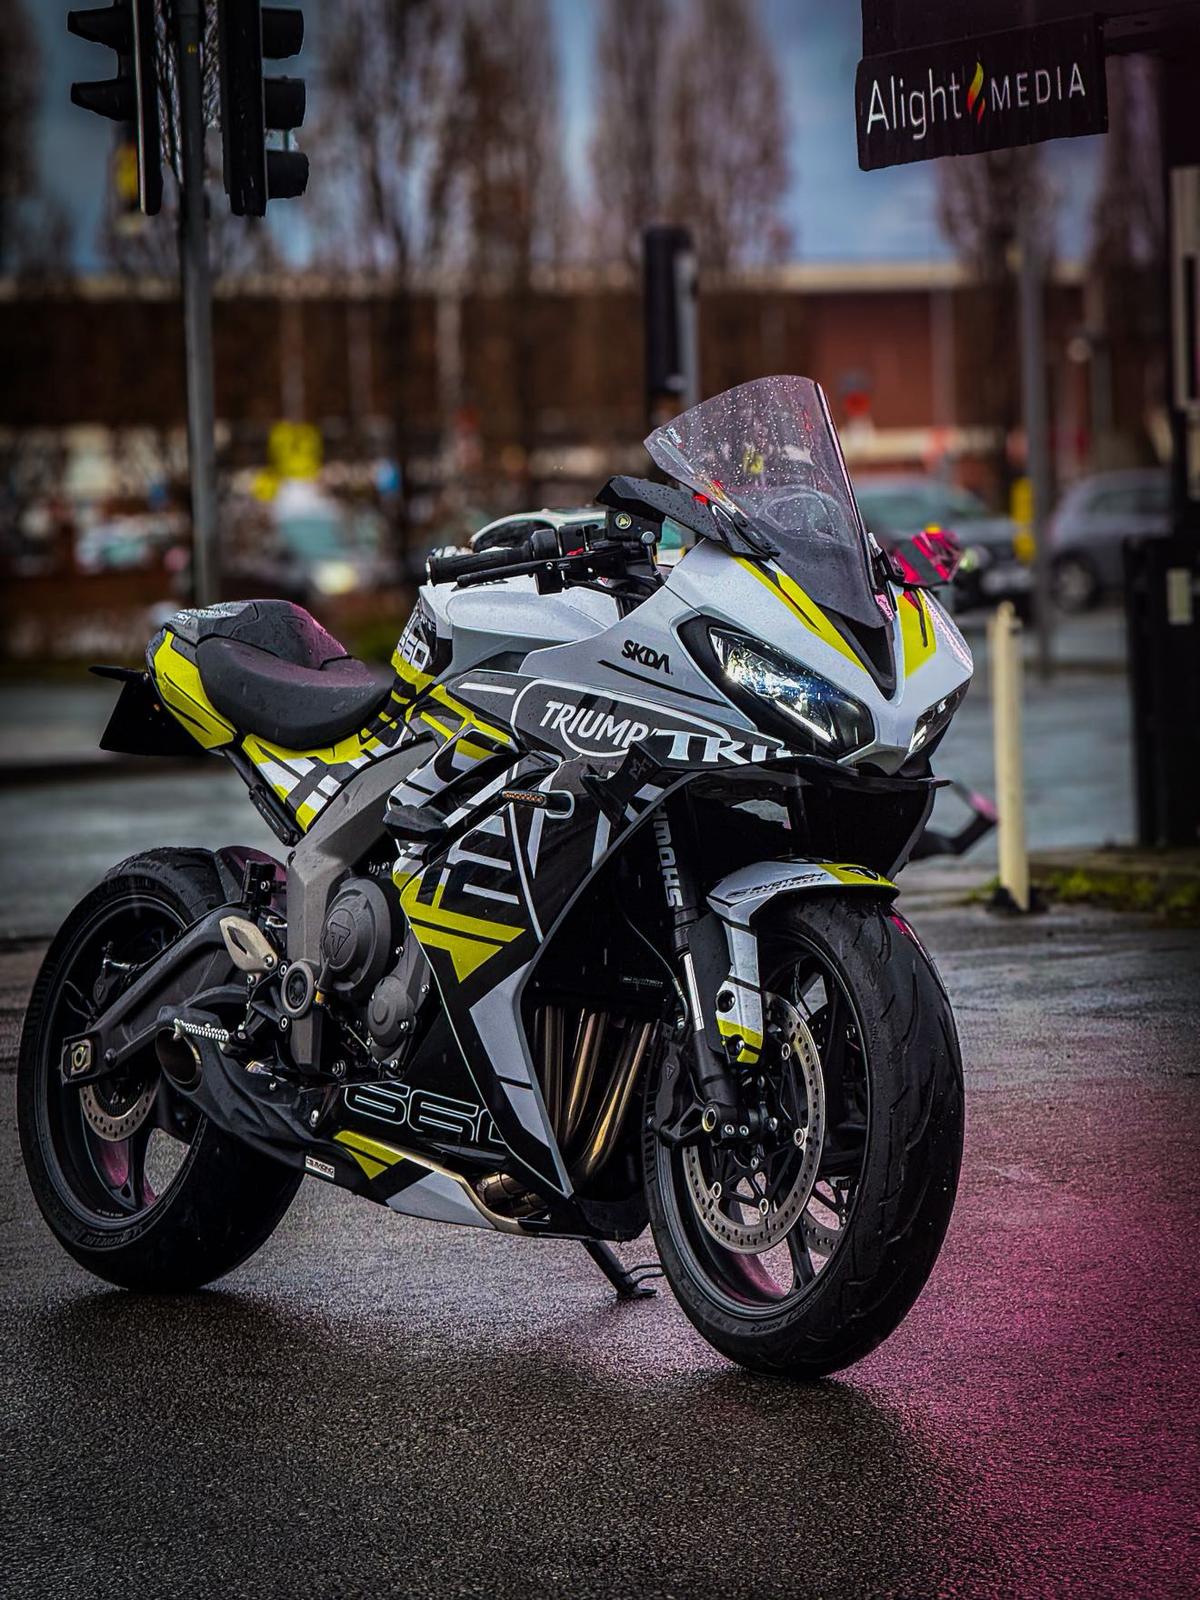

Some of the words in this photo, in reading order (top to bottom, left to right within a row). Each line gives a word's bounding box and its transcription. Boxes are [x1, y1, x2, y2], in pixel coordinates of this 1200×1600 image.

[866, 67, 963, 140] Alight
[990, 61, 1087, 112] MEDIA
[539, 700, 657, 749] TRIUMP
